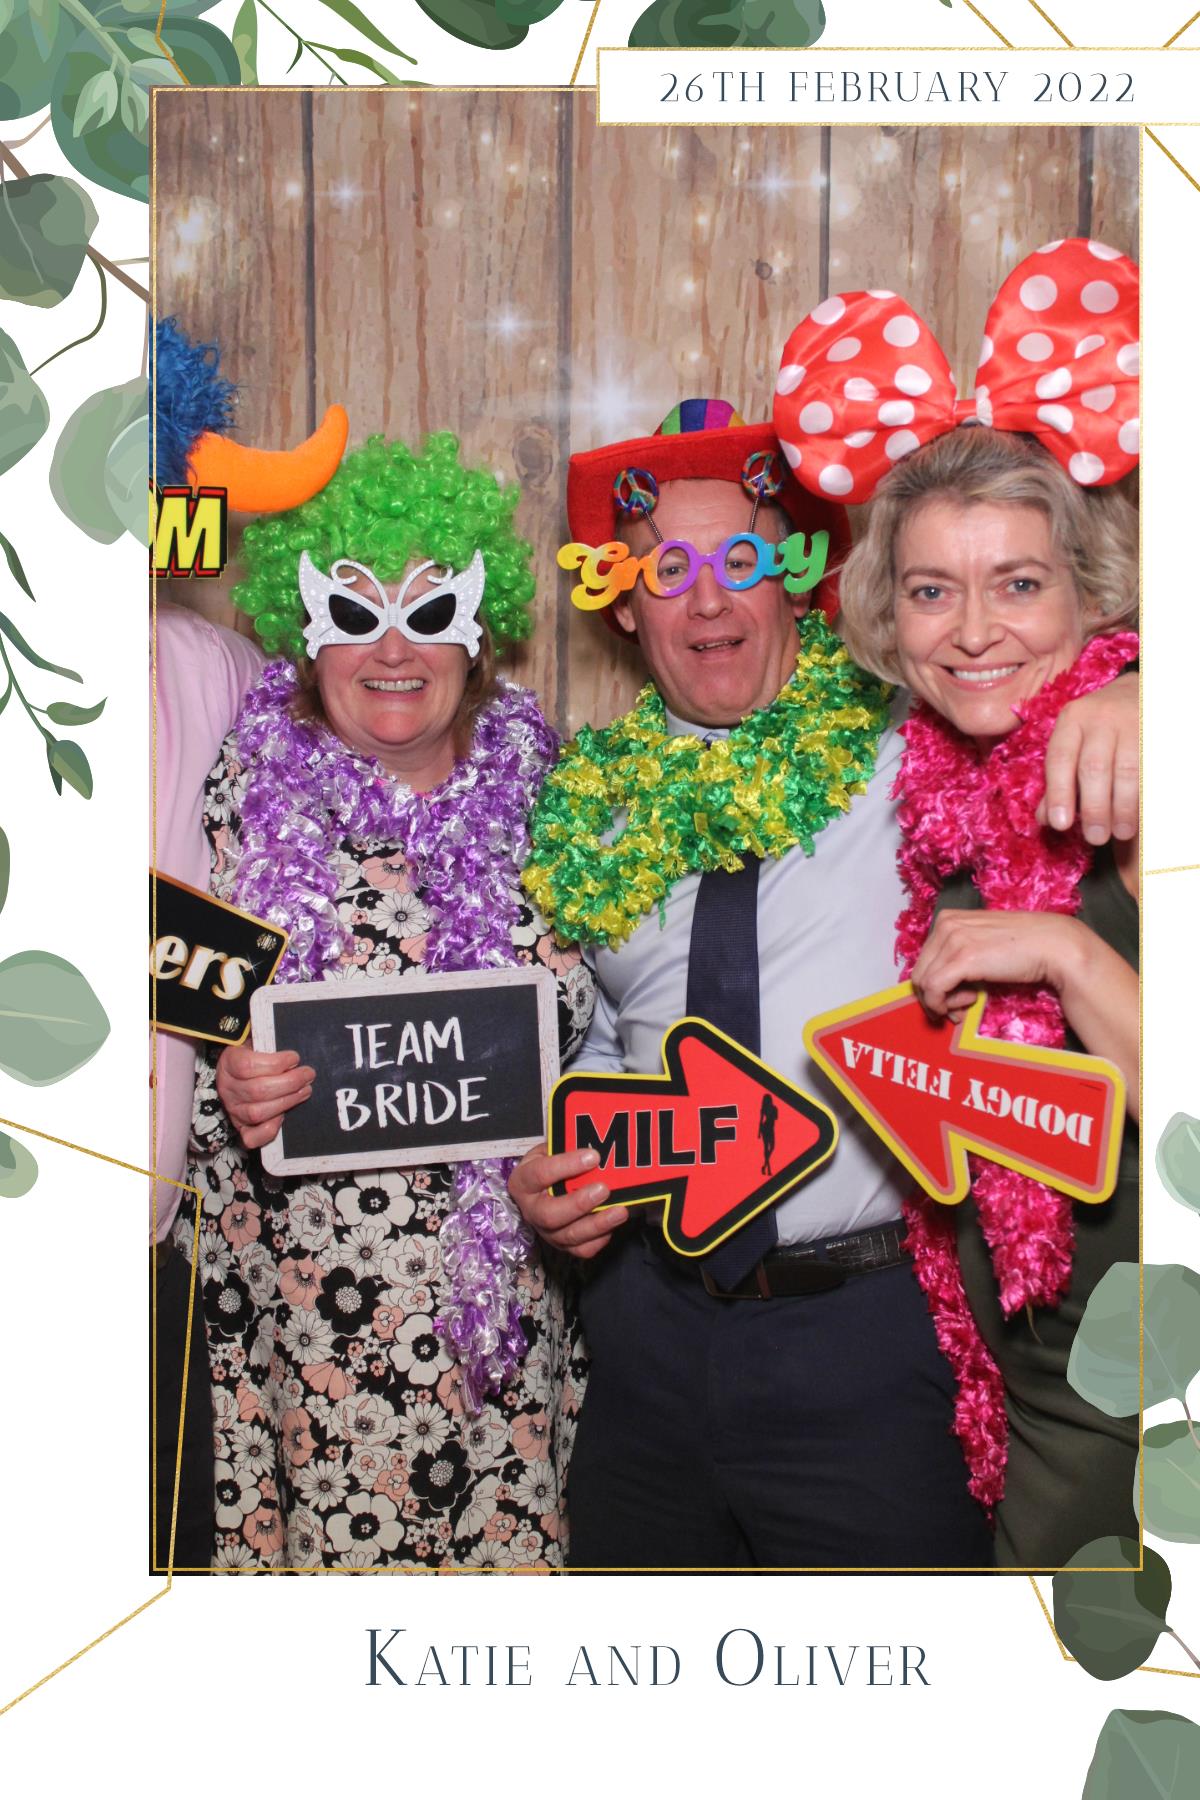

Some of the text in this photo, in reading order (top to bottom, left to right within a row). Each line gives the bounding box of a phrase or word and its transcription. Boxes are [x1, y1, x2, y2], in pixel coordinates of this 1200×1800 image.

[345, 1016, 464, 1070] TEAM
[335, 1076, 490, 1131] BRIDE
[841, 1037, 1094, 1146] DODGY FELLA
[575, 1104, 739, 1170] MILF
